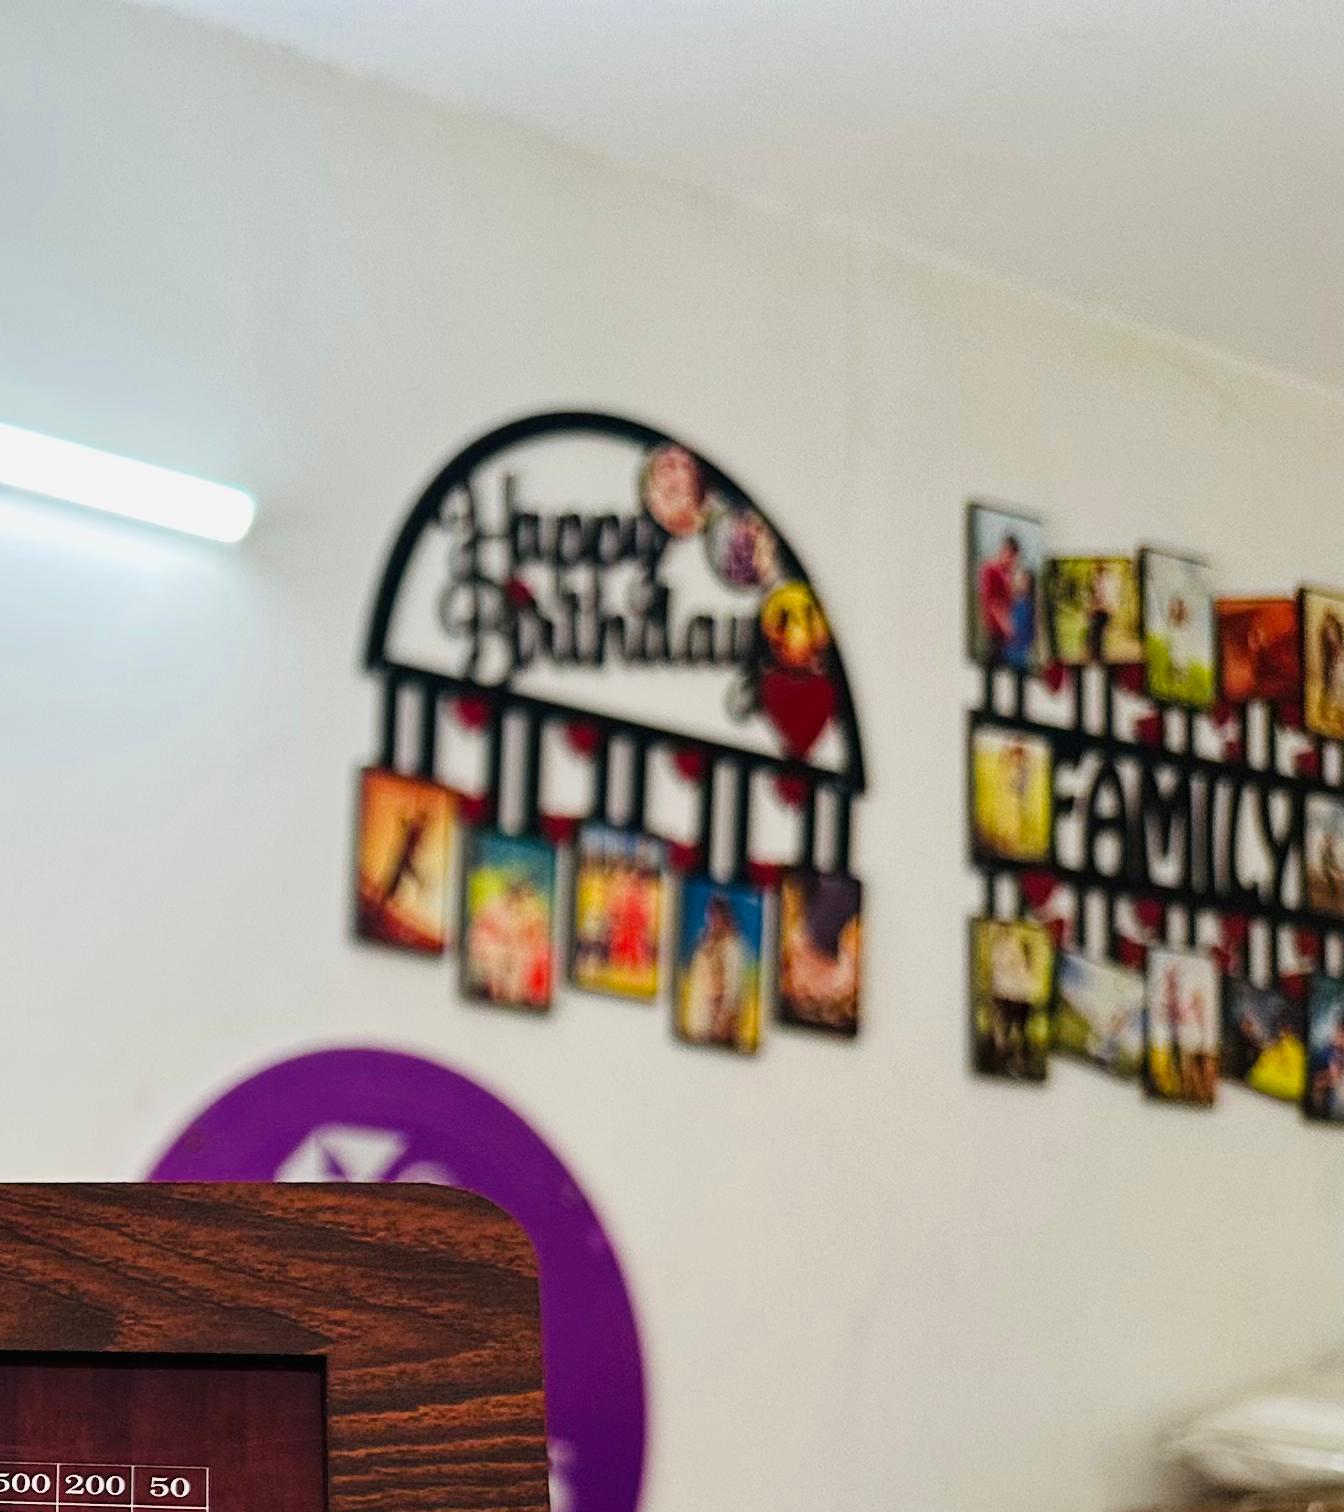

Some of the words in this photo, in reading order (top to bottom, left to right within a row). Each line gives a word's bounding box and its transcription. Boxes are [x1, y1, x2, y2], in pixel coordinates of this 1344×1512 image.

[1048, 734, 1306, 908] FAMILY
[64, 1474, 126, 1496] 200
[149, 1476, 191, 1498] 50
